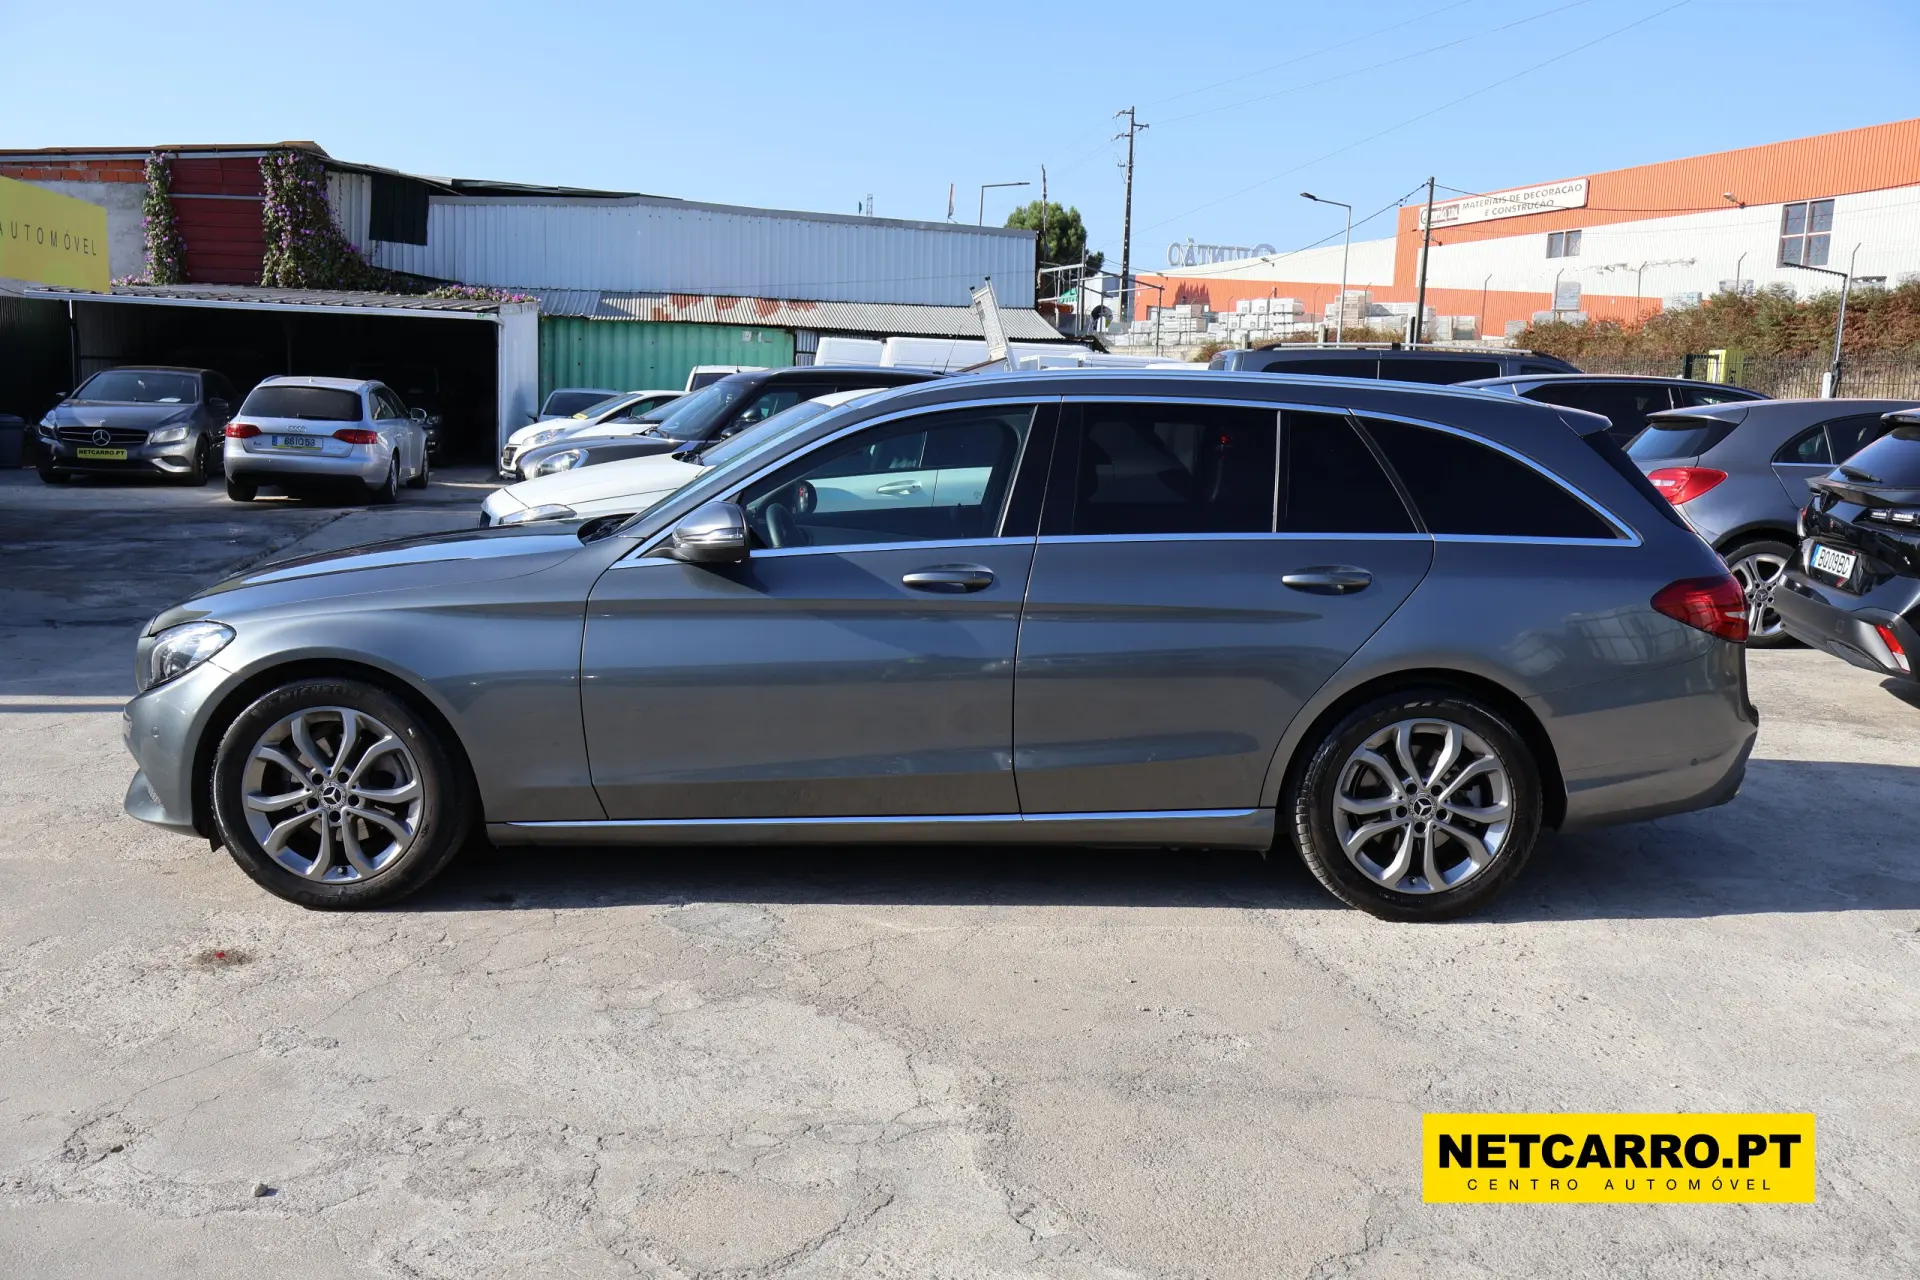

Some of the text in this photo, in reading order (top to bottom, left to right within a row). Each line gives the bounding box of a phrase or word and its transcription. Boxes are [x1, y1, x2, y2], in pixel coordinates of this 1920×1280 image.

[1462, 196, 1507, 210] MATERIAIS
[1509, 193, 1520, 202] DE
[1485, 208, 1490, 216] E
